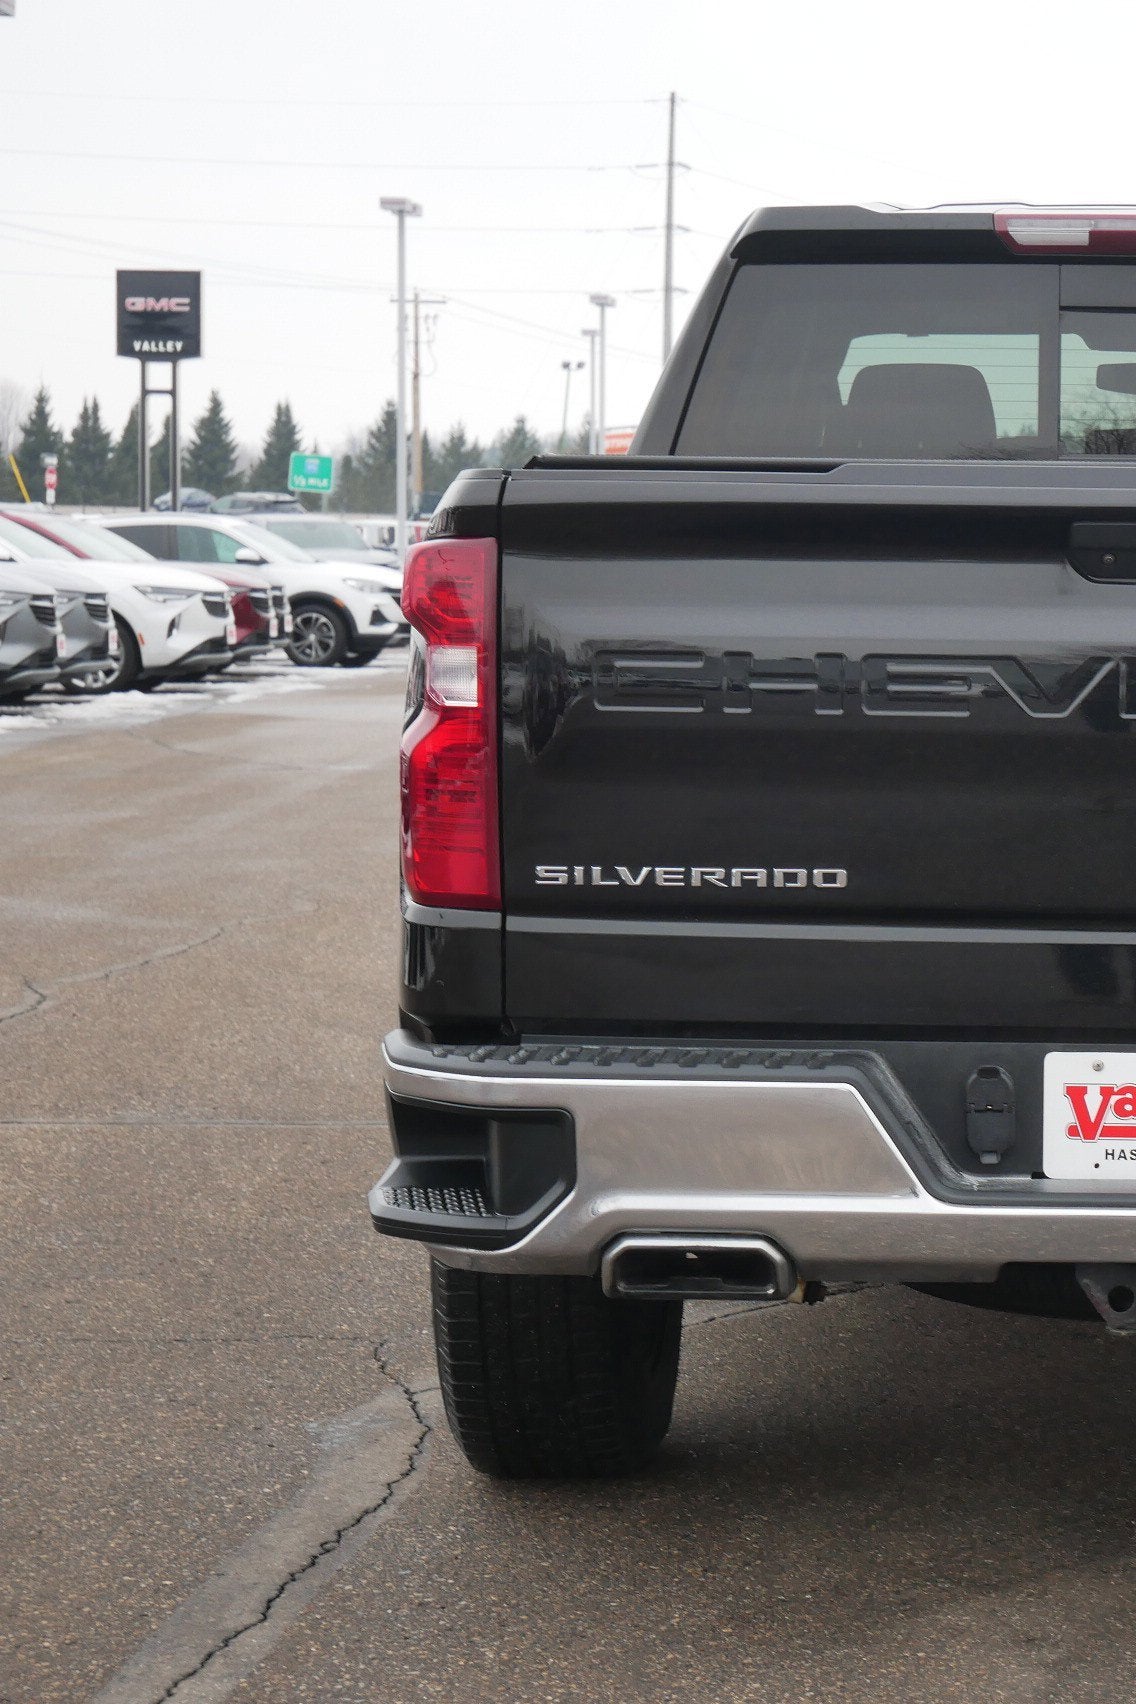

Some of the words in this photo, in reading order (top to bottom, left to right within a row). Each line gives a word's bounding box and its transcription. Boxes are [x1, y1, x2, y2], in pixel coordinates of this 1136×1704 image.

[124, 296, 191, 312] GMC
[132, 340, 183, 353] VALLEY
[534, 864, 849, 889] SILVERADO
